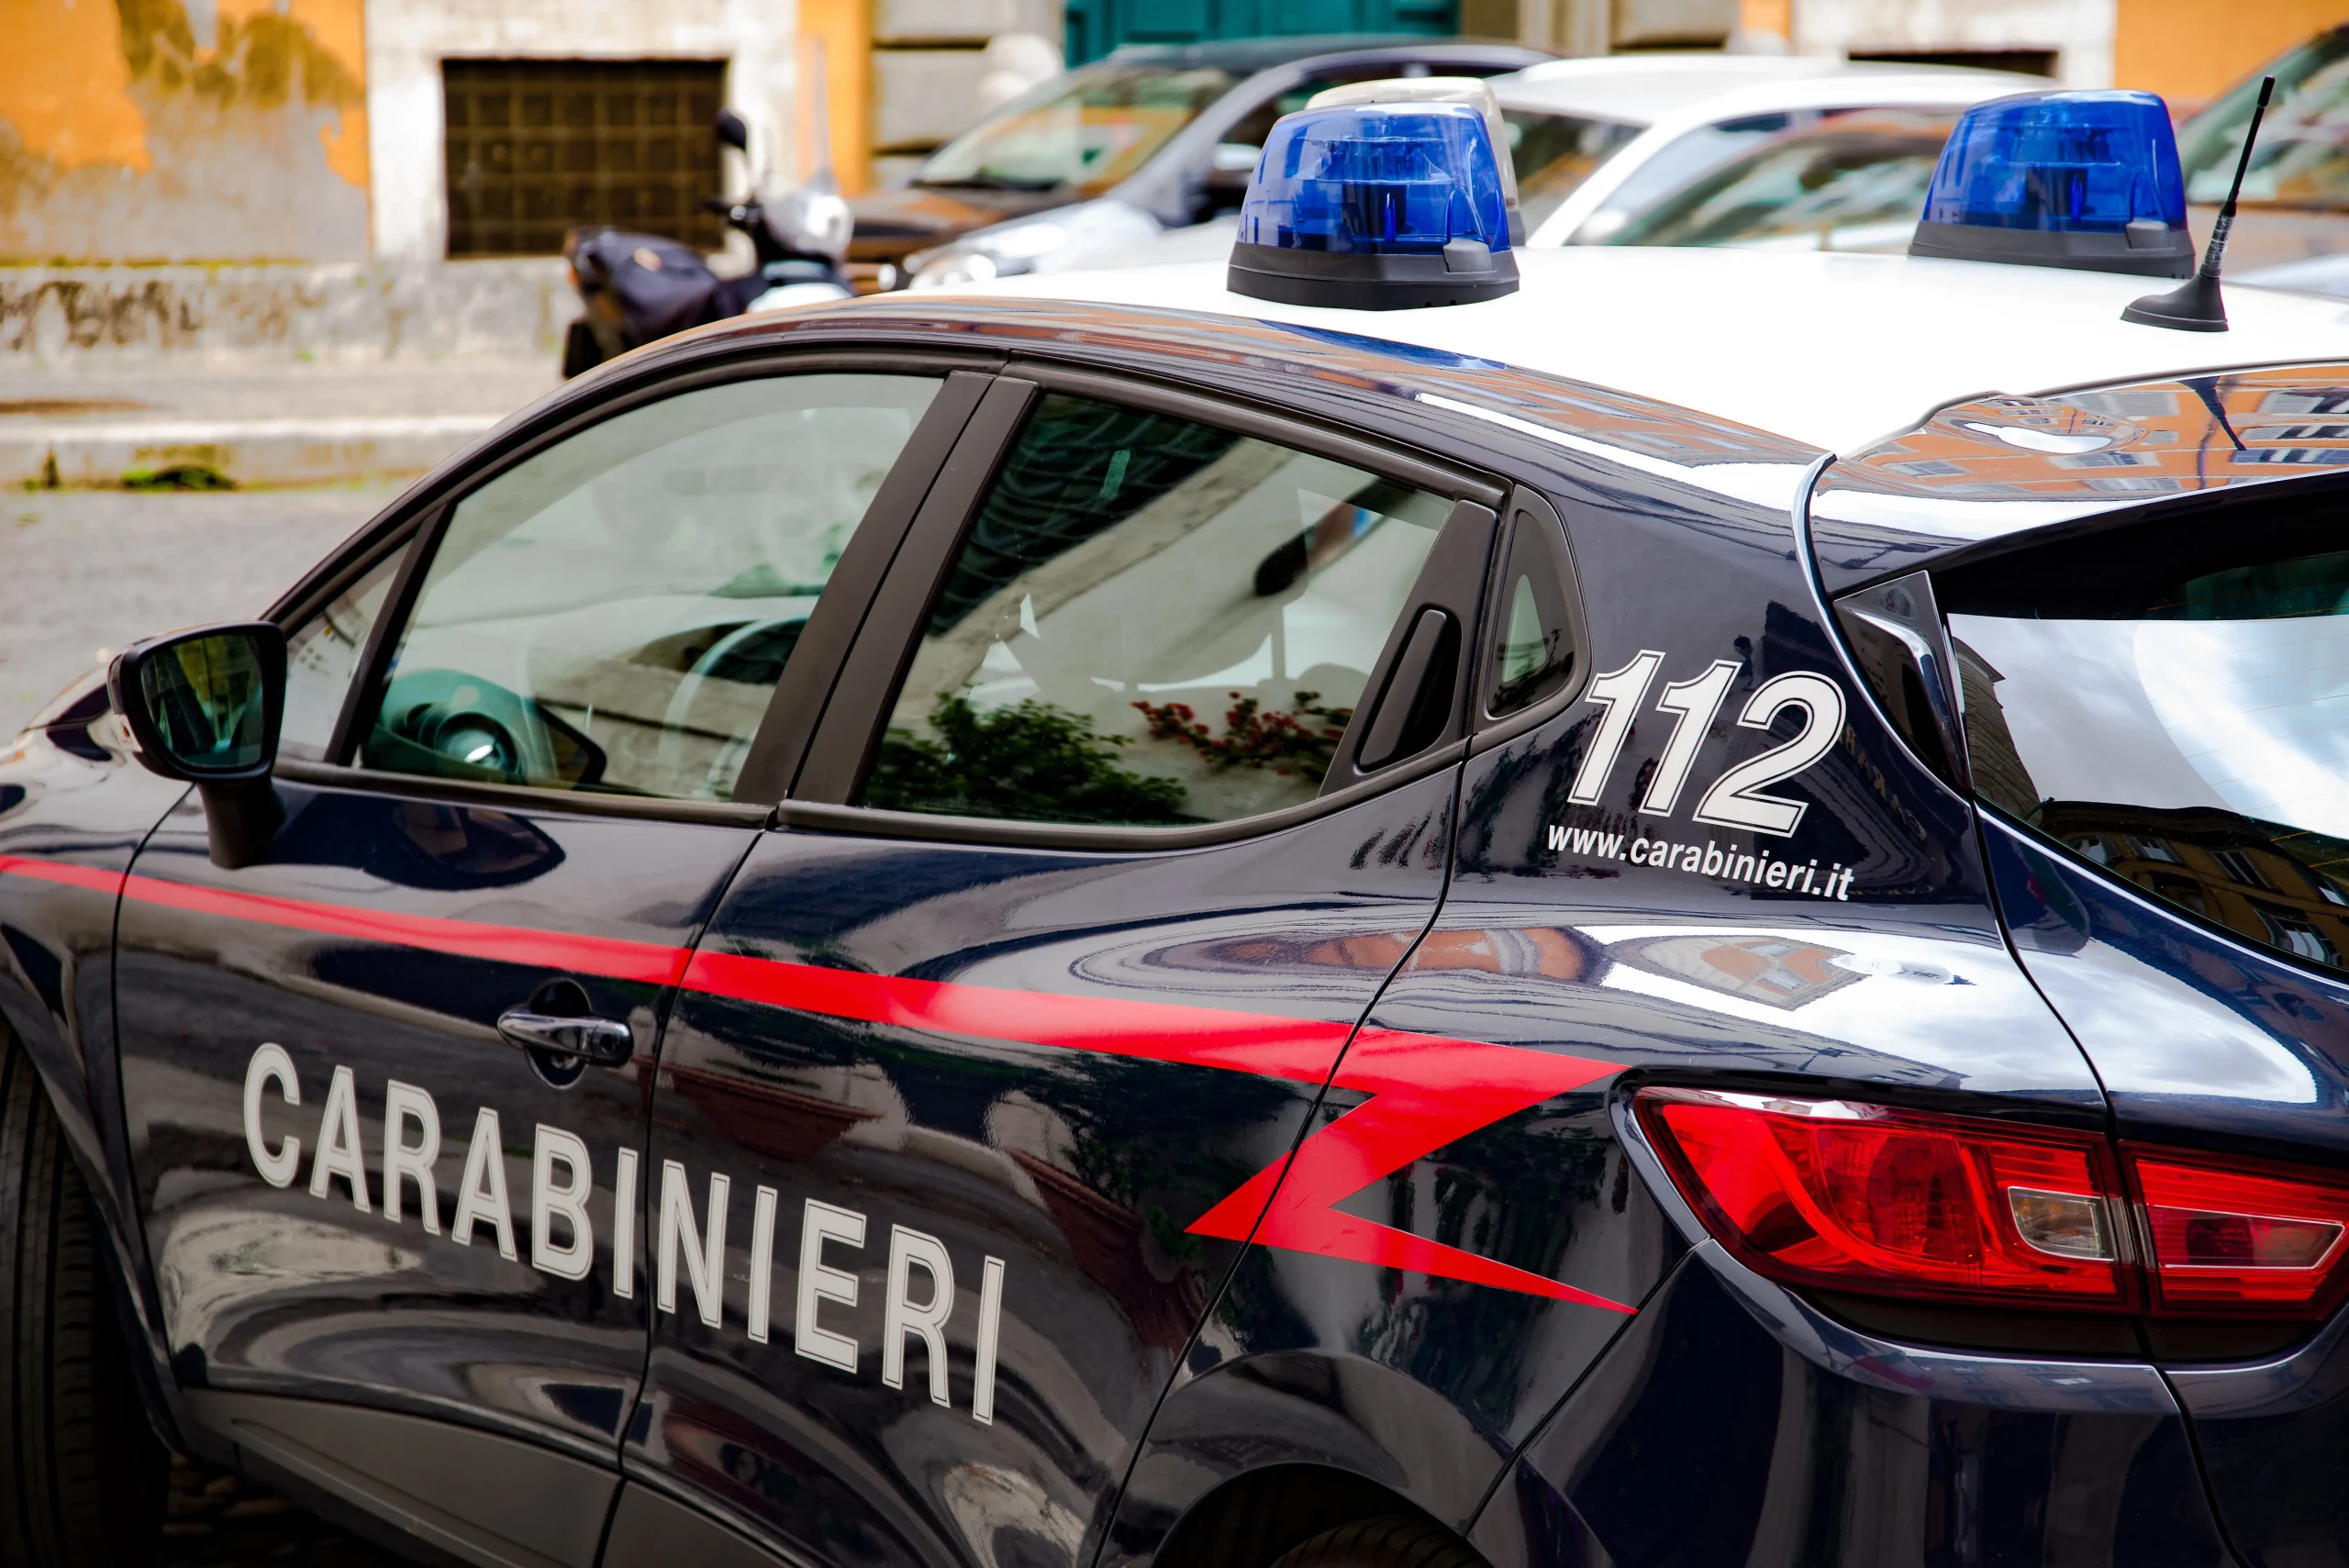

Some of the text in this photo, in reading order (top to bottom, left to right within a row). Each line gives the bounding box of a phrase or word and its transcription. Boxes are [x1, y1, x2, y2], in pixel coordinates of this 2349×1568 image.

[1567, 650, 1846, 839] 112
[1548, 825, 1855, 901] www.carabinieri.it
[243, 1042, 1006, 1427] CARABINIERI
